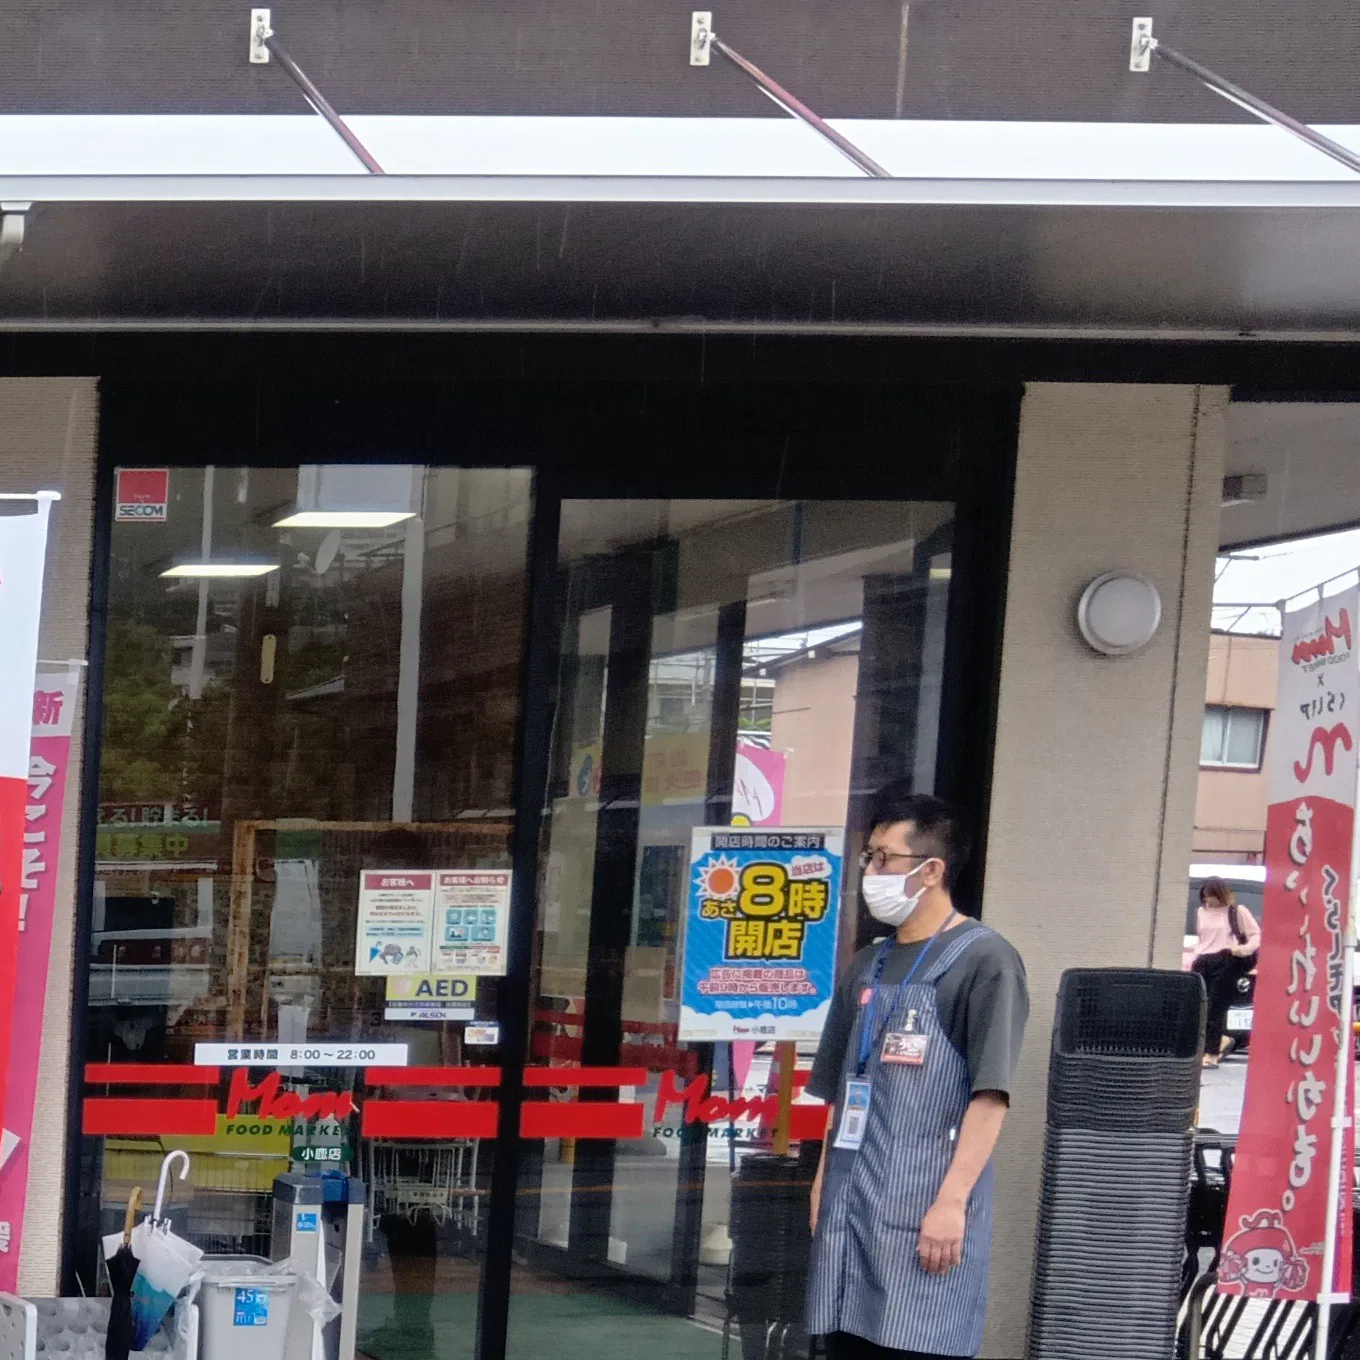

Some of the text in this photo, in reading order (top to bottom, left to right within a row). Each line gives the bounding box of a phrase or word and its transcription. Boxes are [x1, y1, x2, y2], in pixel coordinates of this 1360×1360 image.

[120, 505, 163, 516] SECOM
[714, 835, 821, 849] 開店時間のご案内
[791, 862, 826, 877] 当店は
[728, 921, 803, 957] 開店
[415, 979, 469, 997] AED
[227, 1048, 278, 1061] 営業時間
[226, 1124, 273, 1136] FOOD
[236, 1290, 254, 1303] 45
